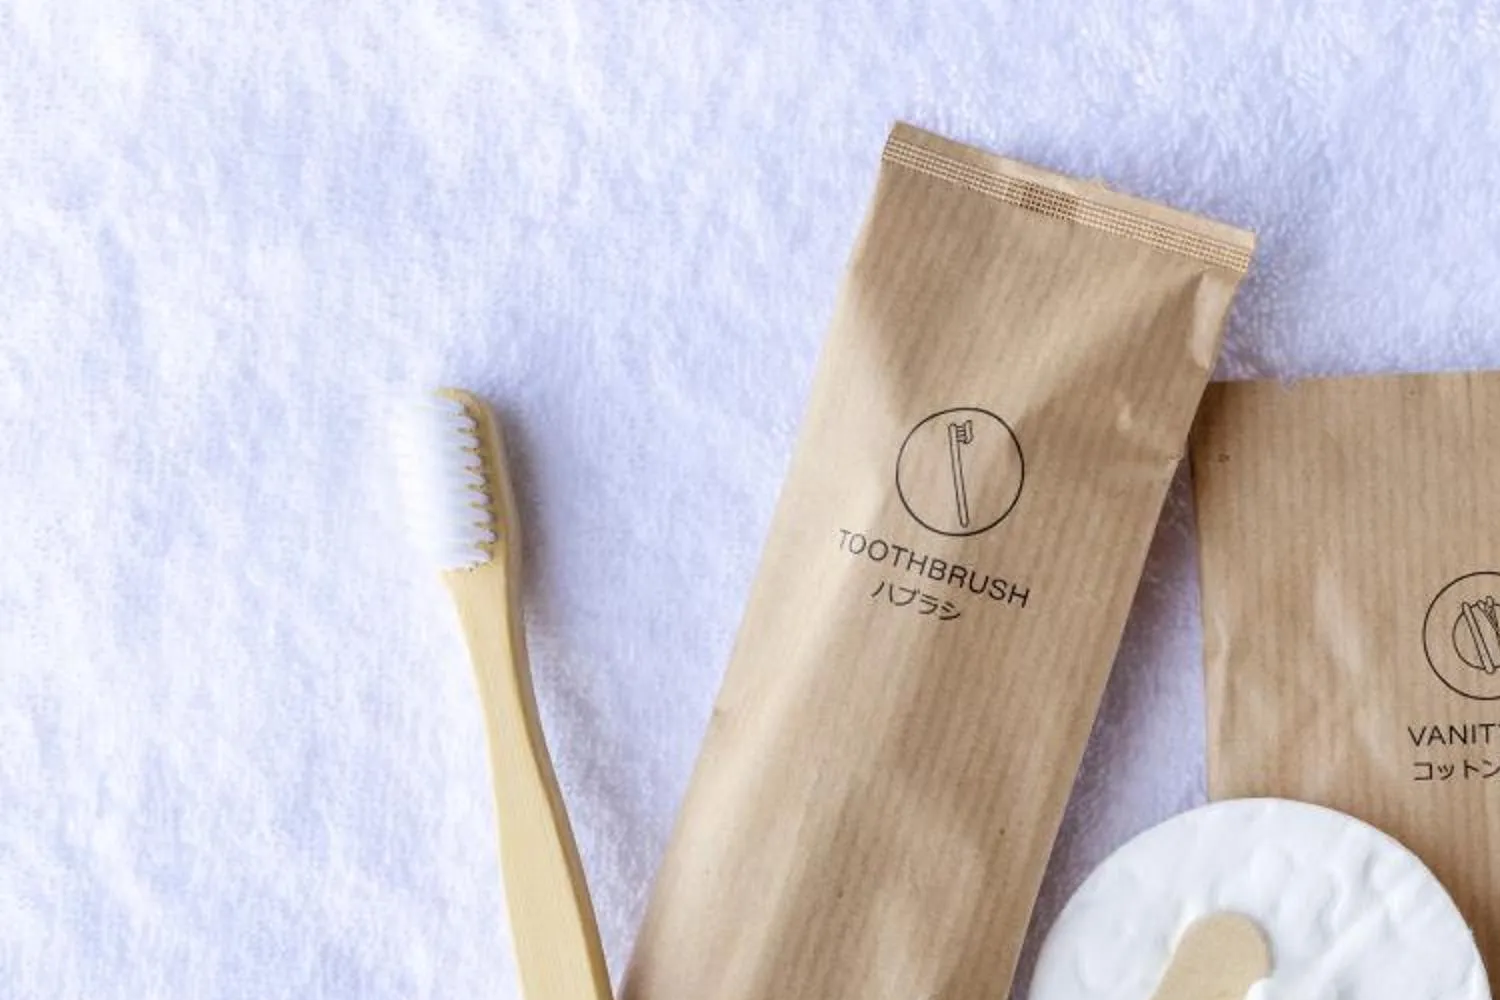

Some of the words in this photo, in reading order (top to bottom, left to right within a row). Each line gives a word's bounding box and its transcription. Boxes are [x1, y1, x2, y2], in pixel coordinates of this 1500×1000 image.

[839, 528, 1031, 609] TOOTHBRUSH
[871, 580, 961, 621] ハブラシ
